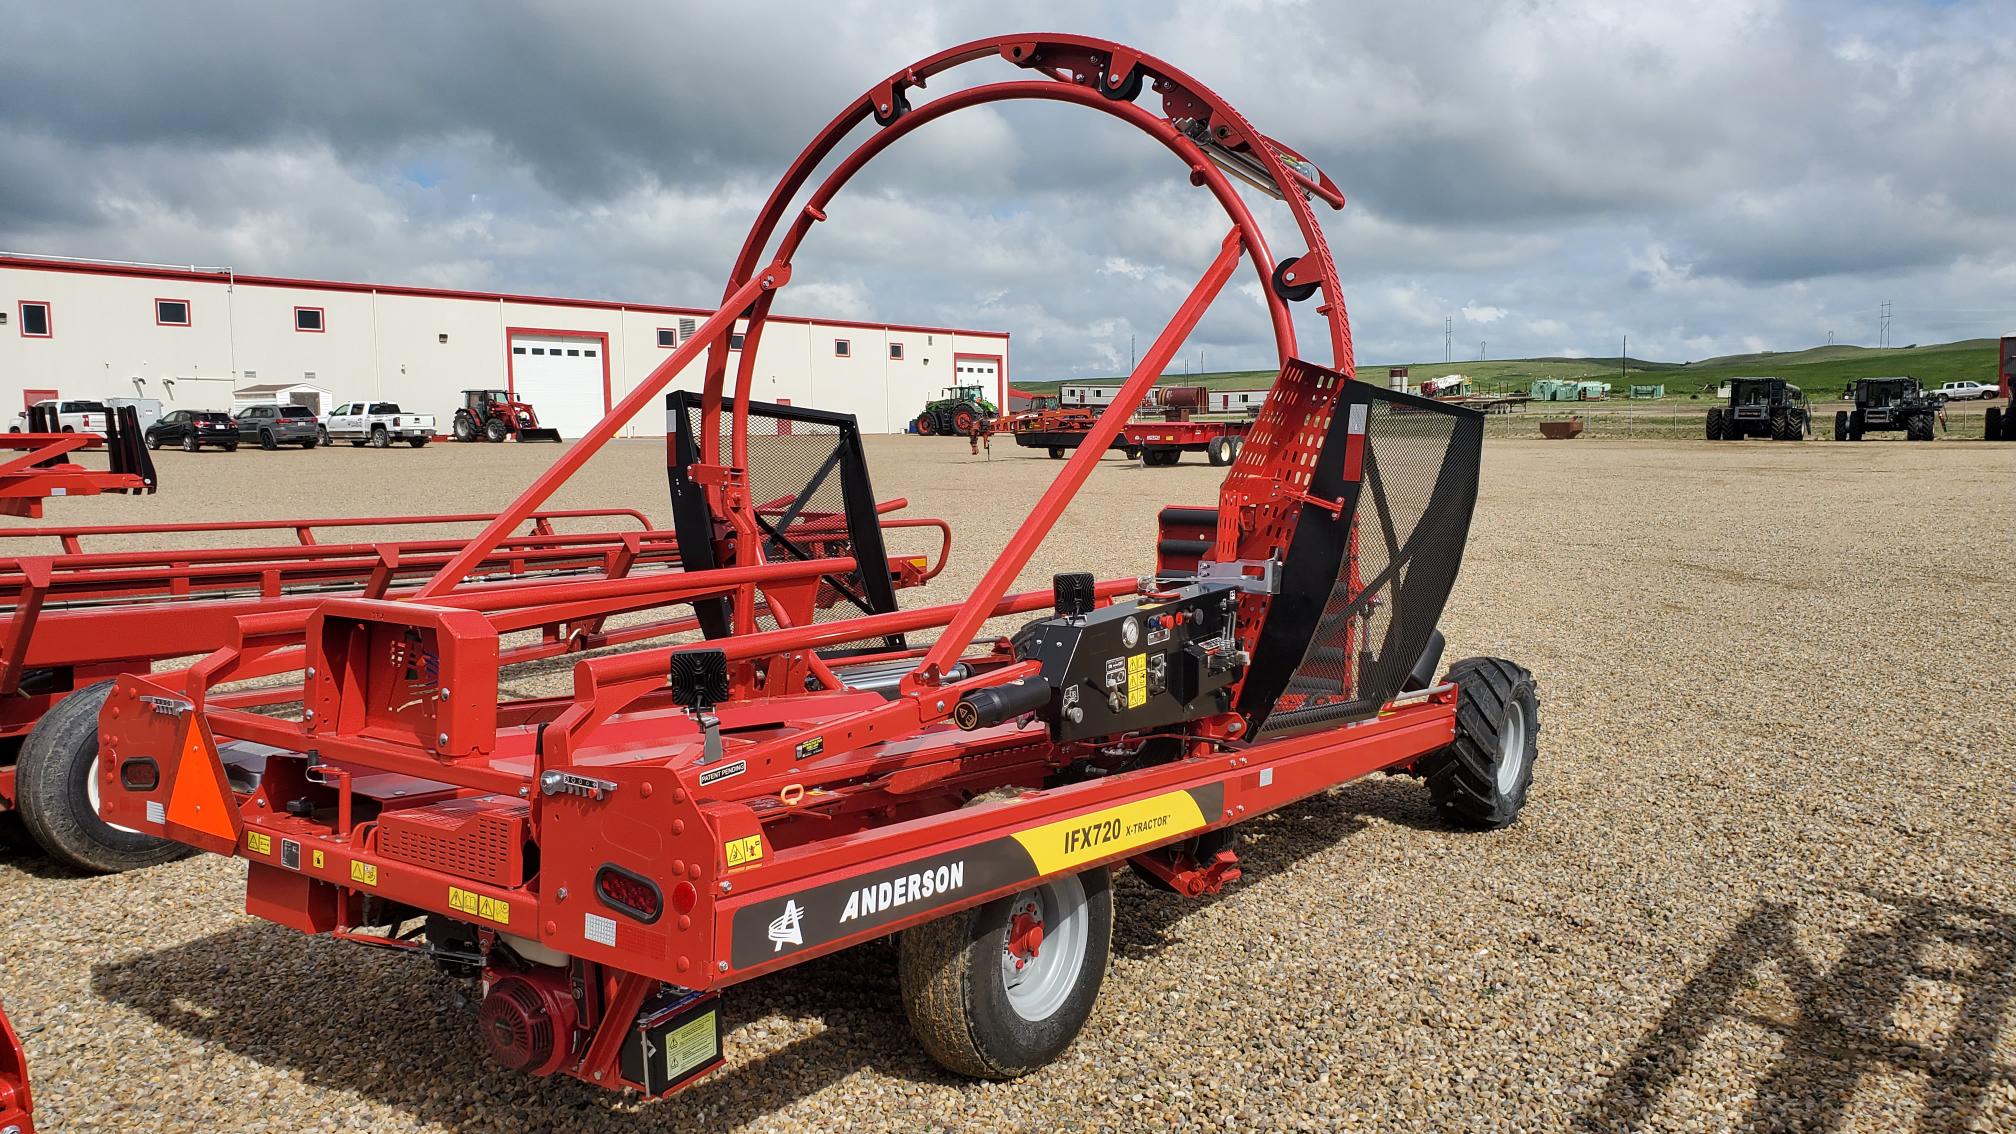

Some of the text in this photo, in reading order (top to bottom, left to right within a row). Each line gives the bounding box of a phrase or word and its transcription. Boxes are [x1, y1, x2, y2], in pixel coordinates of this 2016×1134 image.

[701, 764, 744, 782] PATENT PENDING
[1065, 818, 1121, 854] IFX720
[839, 861, 964, 923] ANDERSON
